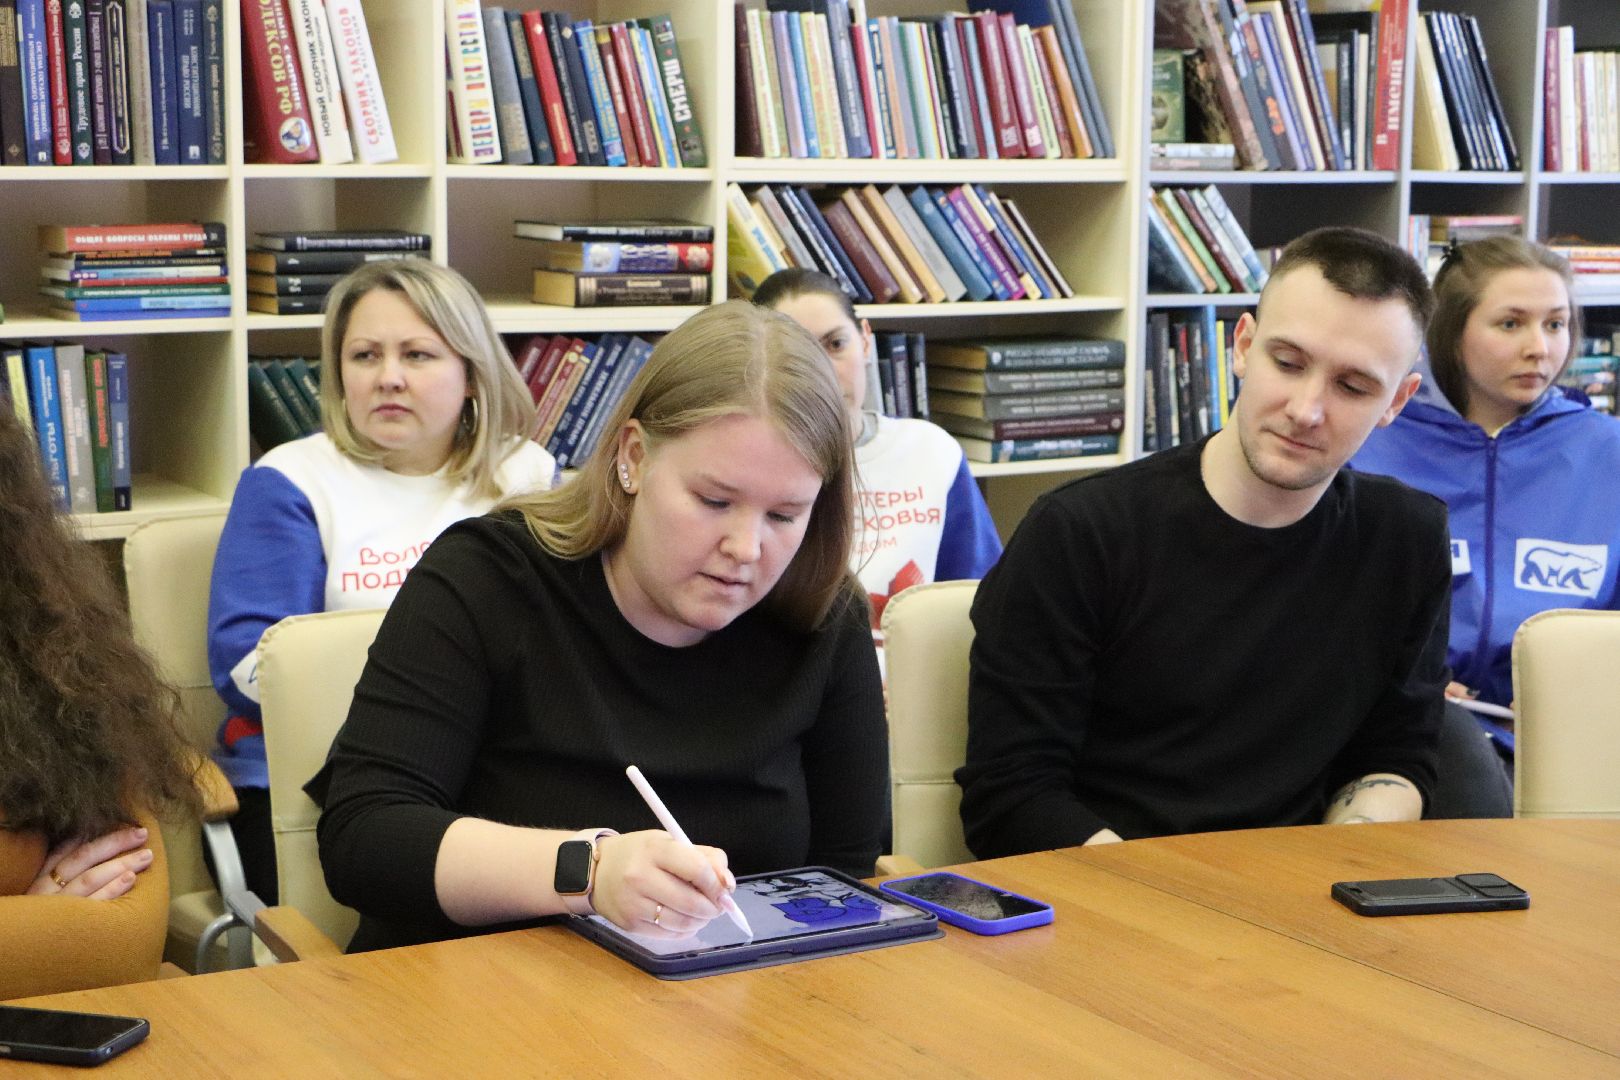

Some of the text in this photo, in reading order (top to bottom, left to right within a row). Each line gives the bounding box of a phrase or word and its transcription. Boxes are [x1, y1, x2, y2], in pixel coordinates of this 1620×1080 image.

[72, 28, 89, 132] Трудовое право России
[309, 43, 325, 93] СБОРНИК
[338, 7, 380, 145] СБОРНИК ЗАКОНОВ
[663, 58, 692, 123] СМЕРШ
[276, 86, 293, 115] РФ
[315, 96, 331, 137] НОВЫЙ
[106, 234, 145, 243] ВОПРОСЫ
[342, 567, 411, 592] ПОД
